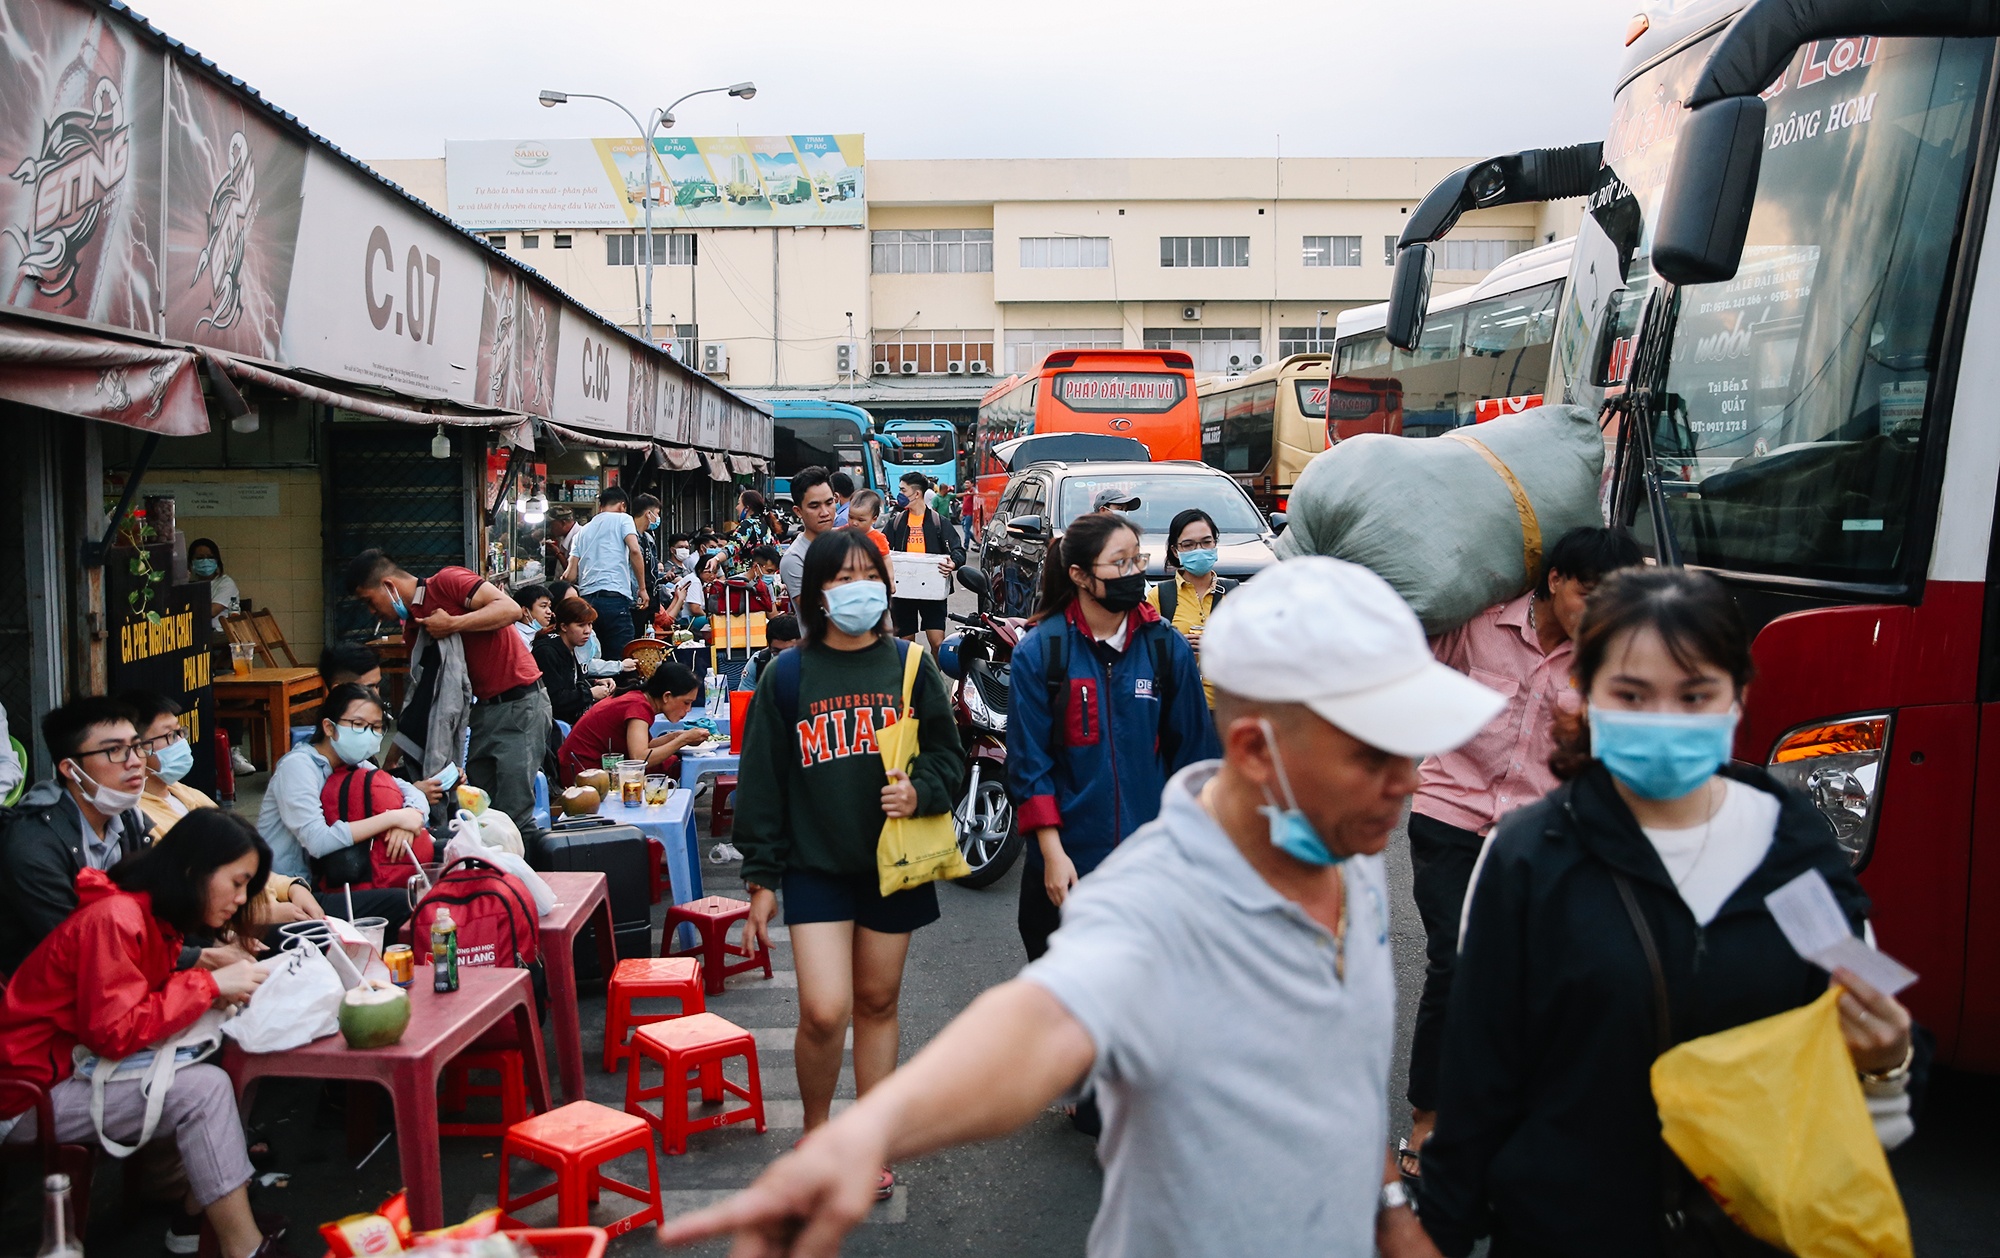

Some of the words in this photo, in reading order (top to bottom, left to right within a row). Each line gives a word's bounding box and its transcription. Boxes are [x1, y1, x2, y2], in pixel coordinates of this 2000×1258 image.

[1769, 111, 1821, 149] ĐÔNG
[1824, 92, 1878, 133] HCM
[514, 150, 549, 158] SAMCO
[35, 128, 129, 235] STING
[599, 202, 616, 210] Nam
[365, 225, 441, 346] C.07
[582, 337, 610, 403] C.06
[1065, 378, 1099, 399] PHÁP
[1157, 378, 1175, 399] VŨ
[1708, 380, 1722, 396] Tại
[1706, 420, 1724, 434] 0917
[1726, 420, 1740, 432] 172
[122, 616, 133, 664] CÀ
[183, 655, 197, 693] PHA
[809, 692, 894, 716] UNIVERSITY
[467, 951, 496, 964] LANG
